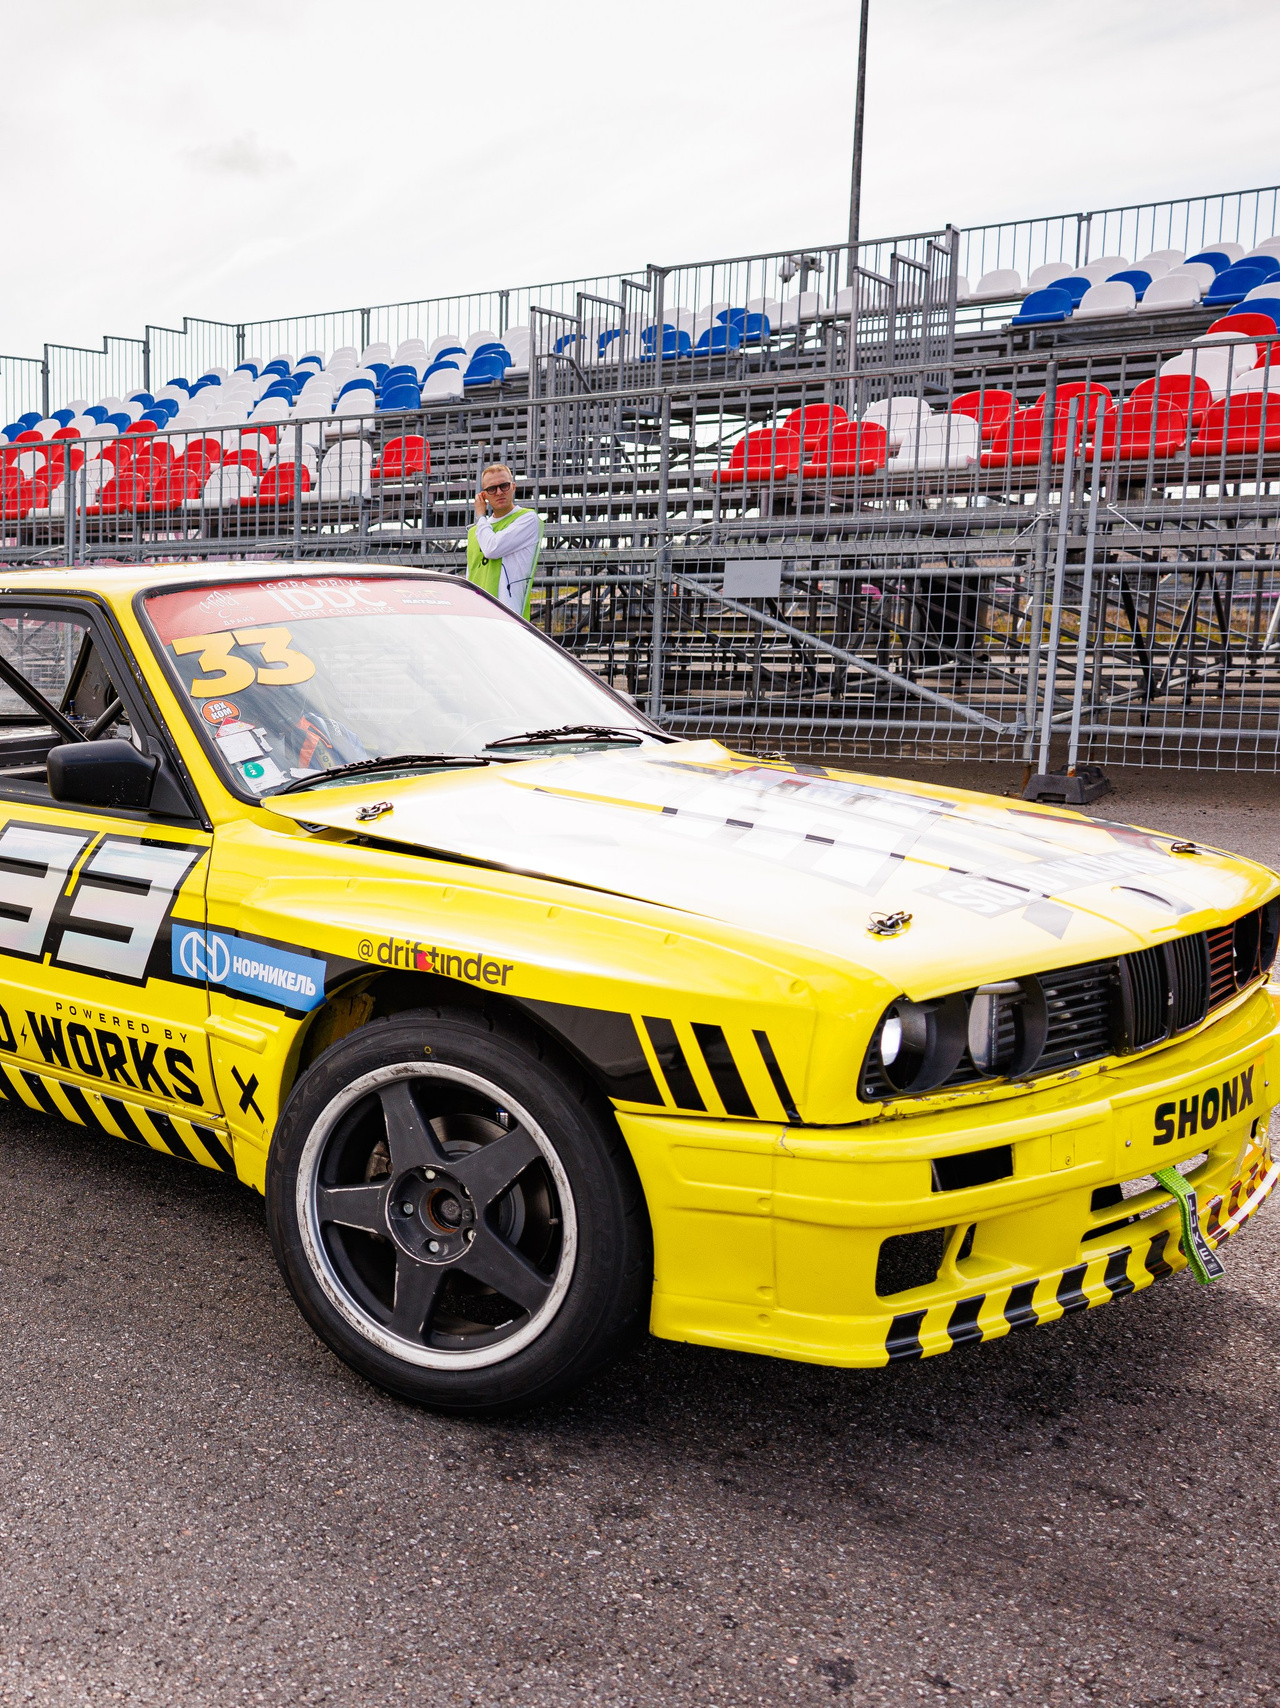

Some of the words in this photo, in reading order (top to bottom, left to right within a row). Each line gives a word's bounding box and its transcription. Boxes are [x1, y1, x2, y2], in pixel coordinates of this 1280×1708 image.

[259, 581, 308, 592] IGORA
[319, 579, 365, 588] DRIVE
[265, 586, 388, 613] IDDC
[223, 615, 256, 626] ДРАЙВ
[289, 608, 329, 619] DRIFT
[330, 605, 400, 616] CHALLENGE
[171, 627, 316, 698] 33
[233, 955, 316, 997] НОРНИКЕЛЬ
[357, 936, 515, 988] @driftinder
[55, 1001, 149, 1034] POWERED
[163, 1029, 188, 1043] BY
[25, 1009, 205, 1107] WORKS
[1153, 1065, 1255, 1147] SHONX
[1188, 1199, 1211, 1261] LUKE
